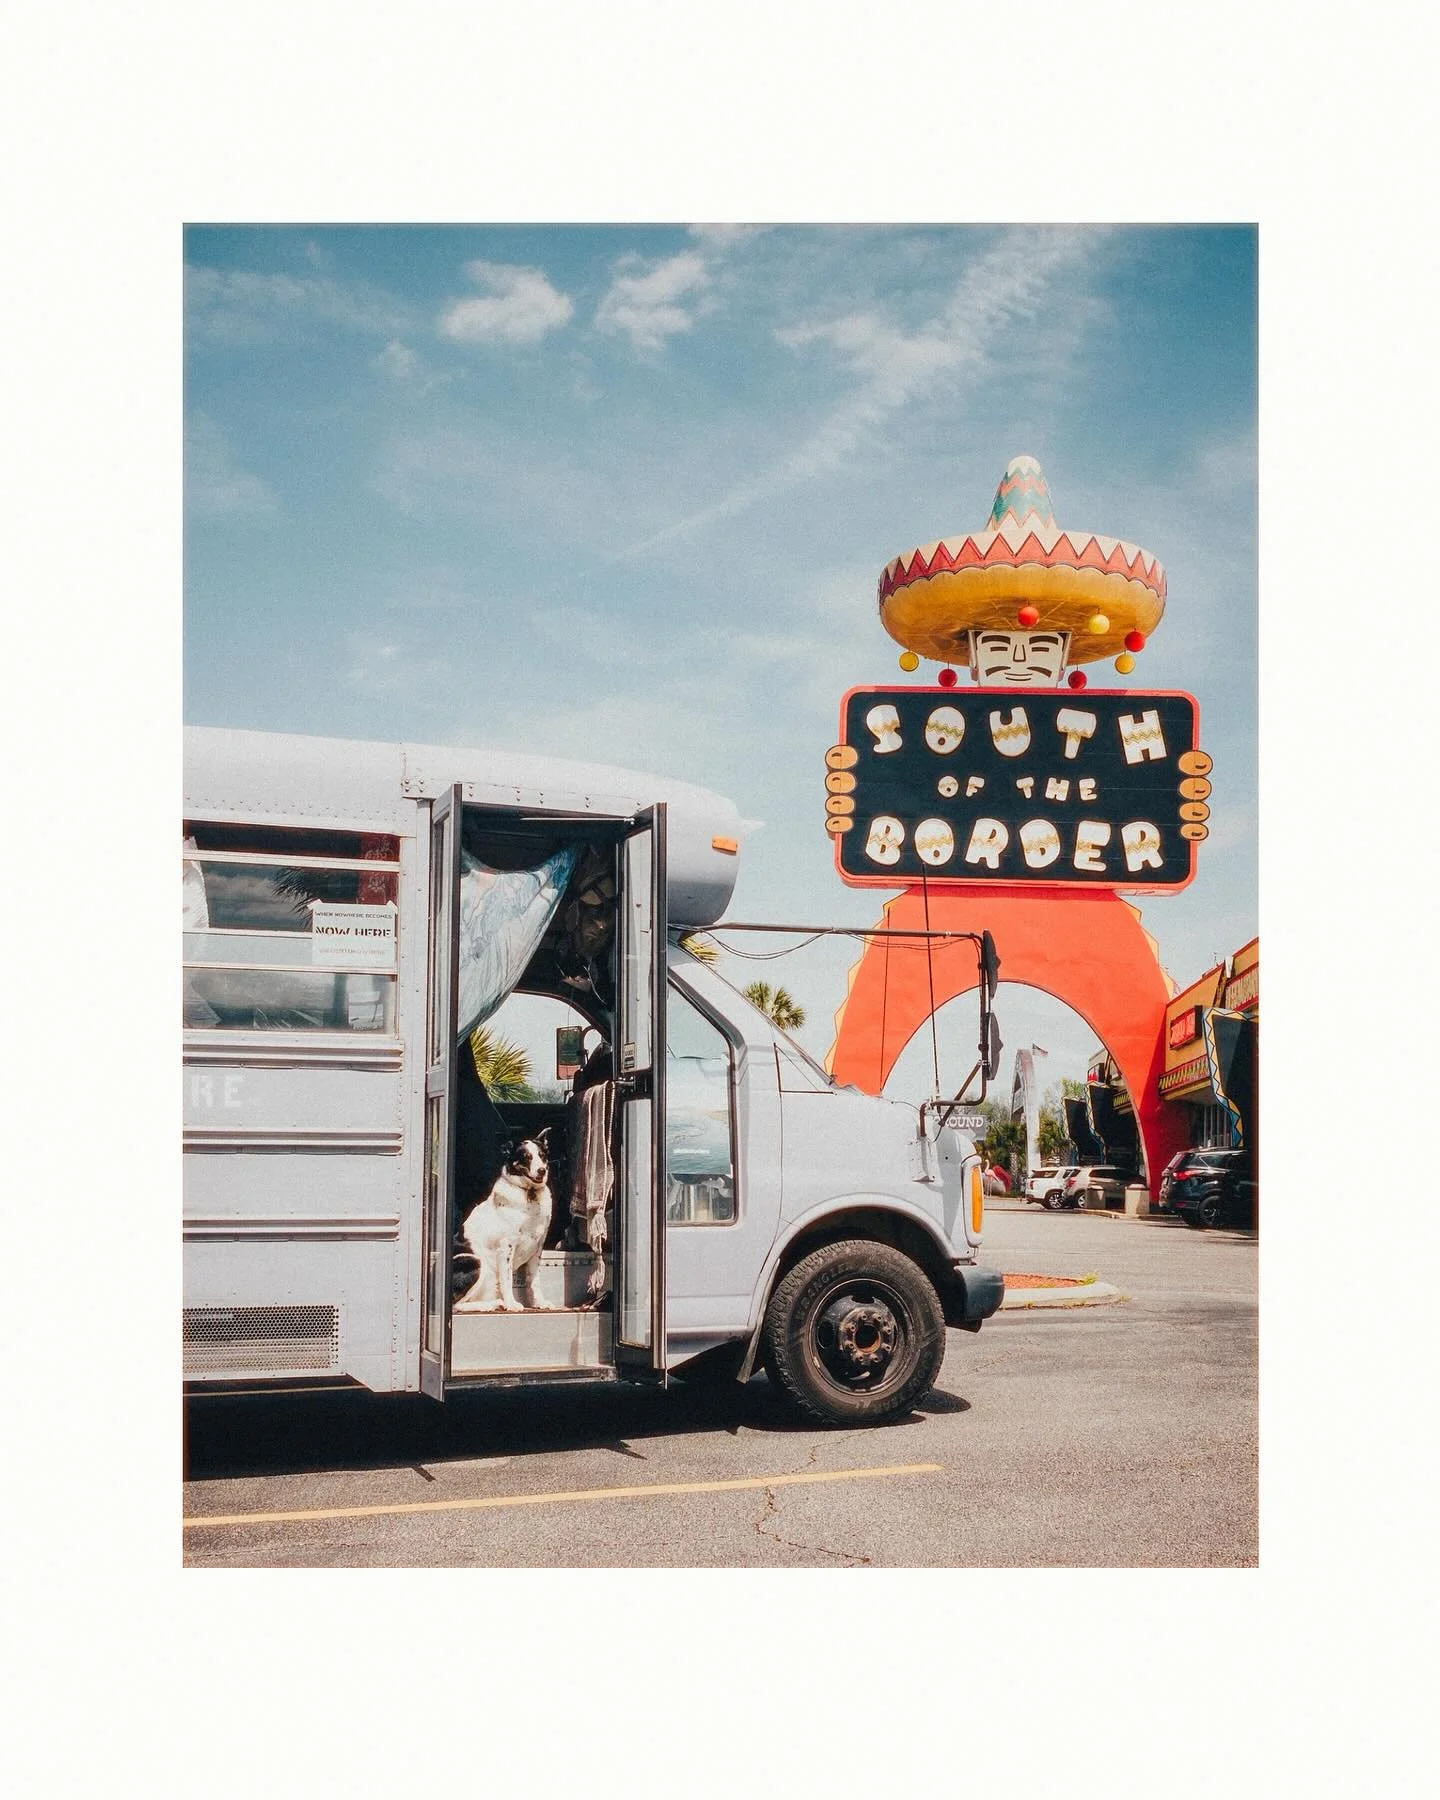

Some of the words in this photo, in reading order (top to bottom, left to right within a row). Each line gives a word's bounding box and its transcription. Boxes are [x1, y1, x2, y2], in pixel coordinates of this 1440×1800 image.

[866, 704, 1167, 765] SOUTH
[937, 776, 985, 799] OF
[1016, 776, 1098, 801] THE
[865, 816, 1164, 873] BORDER
[315, 926, 350, 936] NOW
[354, 927, 391, 937] HERE
